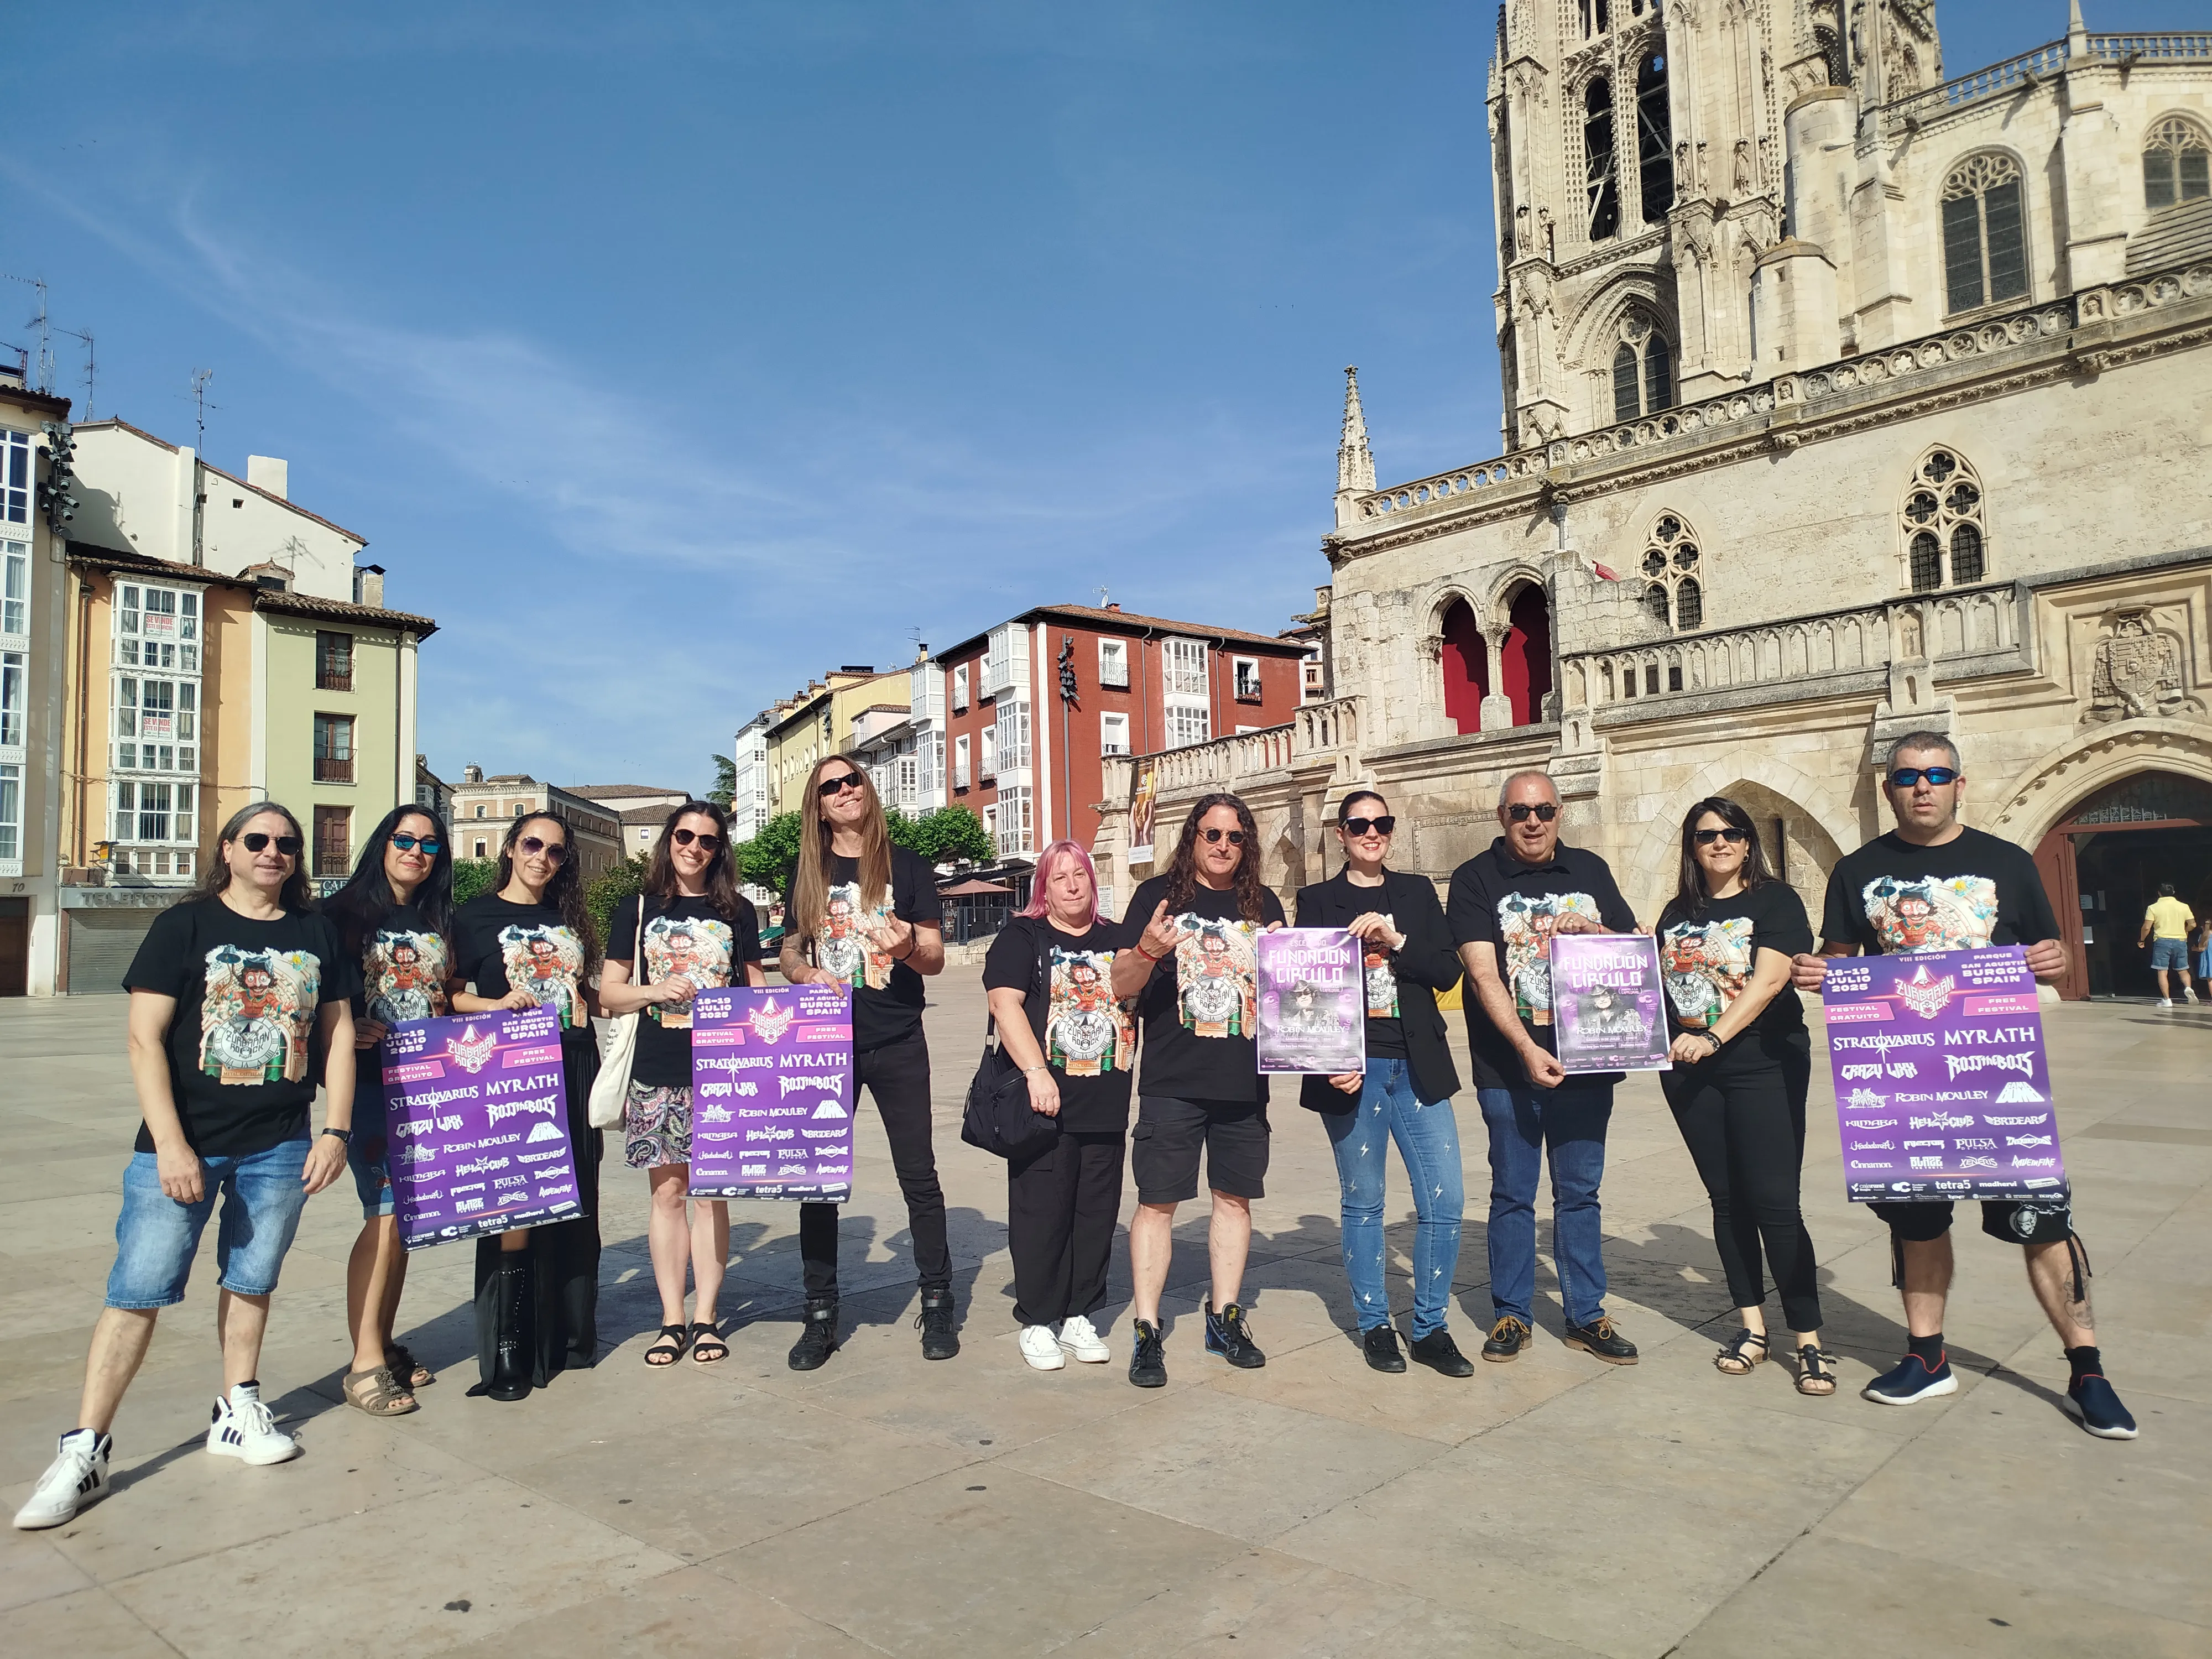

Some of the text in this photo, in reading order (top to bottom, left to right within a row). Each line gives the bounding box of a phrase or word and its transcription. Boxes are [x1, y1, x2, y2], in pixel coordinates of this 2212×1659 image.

[155, 616, 173, 625] VNDE
[152, 718, 171, 727] VNDE
[323, 880, 348, 890] CAF
[81, 892, 175, 907] TELEFOT
[1827, 967, 1869, 977] 18-19
[1963, 966, 2027, 977] BURGOS
[1827, 975, 1871, 984] JULIO
[1972, 975, 2021, 984] SPAIN
[1832, 983, 1868, 992] 2025
[465, 1013, 491, 1022] EDICIÓN
[503, 1021, 554, 1034] BURGOS
[1277, 1025, 1305, 1033] ROBIN
[386, 1029, 425, 1040] 18-19
[510, 1029, 549, 1040] SPAIN
[1944, 1026, 2036, 1045] MYRATH
[386, 1037, 426, 1047] JULIO
[1833, 1031, 1936, 1055] STRATOVARIUS
[390, 1045, 424, 1055] 2025
[514, 1055, 555, 1065] FESTIVAL
[696, 1055, 774, 1074] STRATOVARIUS
[779, 1052, 847, 1068] MYRATH
[388, 1065, 431, 1074] FESTIVAL
[1841, 1063, 1882, 1081] CRAZY
[388, 1072, 433, 1082] GRATUITO
[486, 1073, 559, 1096] MYRATH
[390, 1086, 479, 1112] STRATOVARIUS
[1895, 1092, 1933, 1102] ROBIN
[738, 1109, 768, 1117] ROBIN
[1991, 1115, 2041, 1126] BRIDEAR
[443, 1141, 476, 1154] ROBIN
[1953, 1138, 1999, 1149] PULSA
[776, 1149, 809, 1159] PULSA
[492, 1174, 529, 1189] PULSA
[1935, 1180, 1971, 1189] tetra5
[755, 1185, 782, 1193] tetra5
[478, 1214, 508, 1228] tetra5
